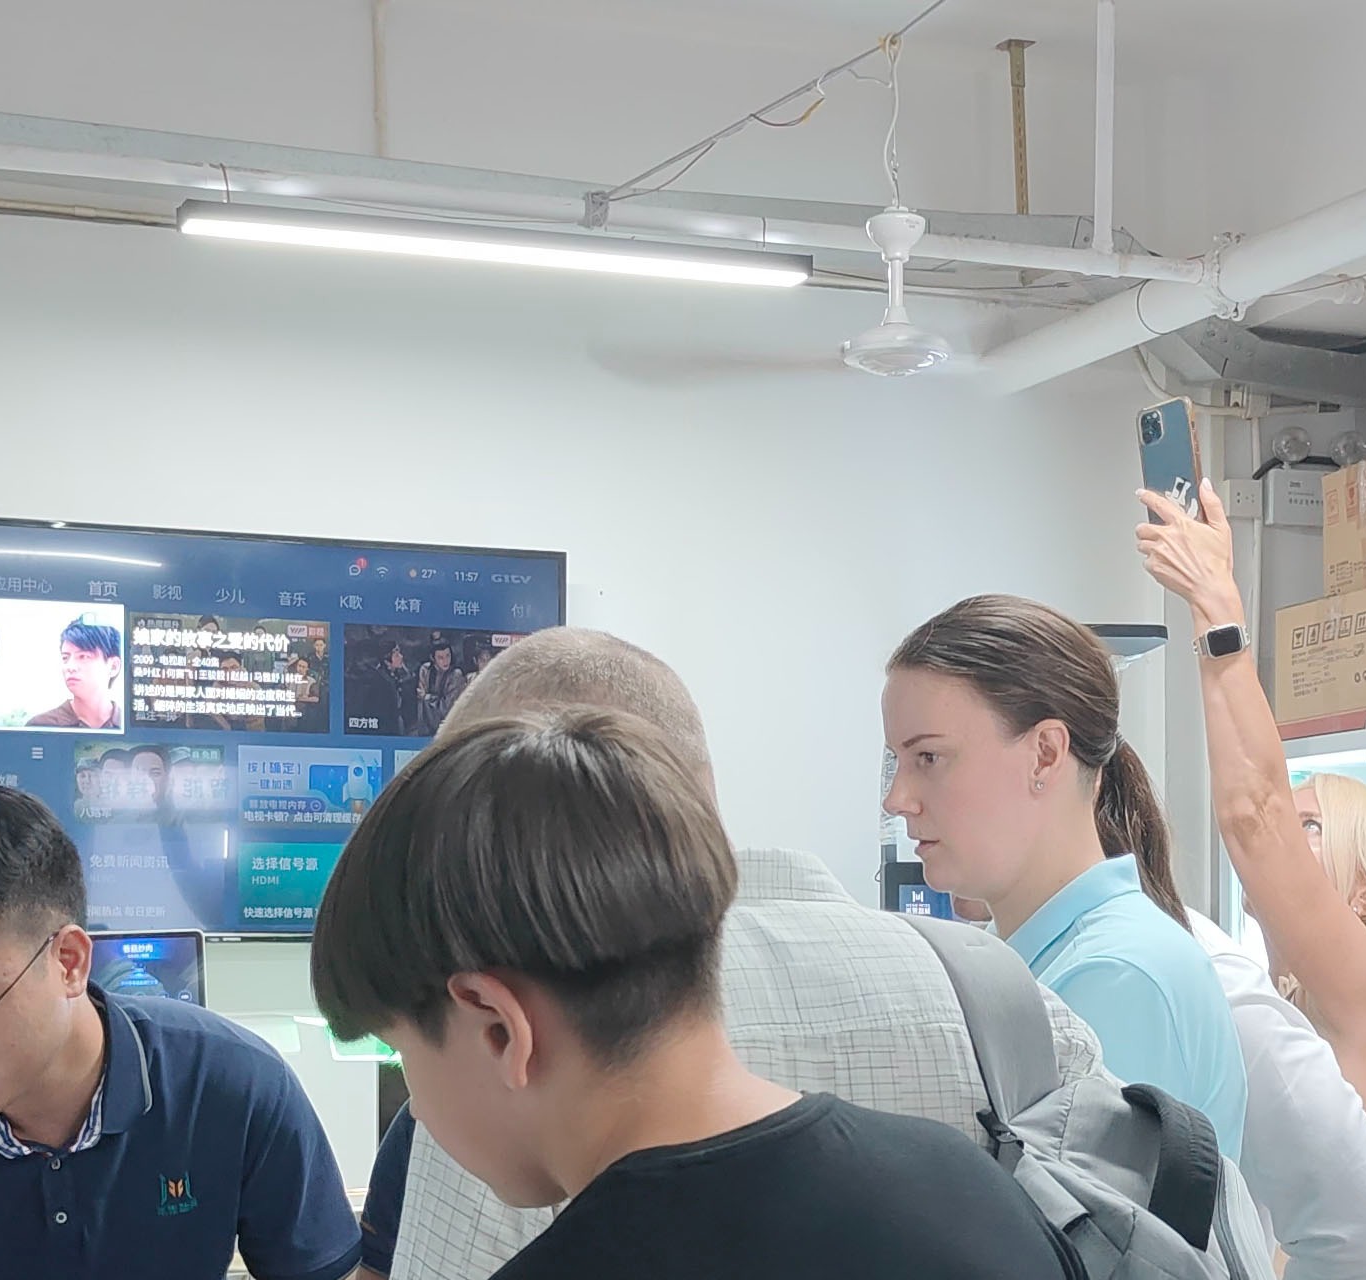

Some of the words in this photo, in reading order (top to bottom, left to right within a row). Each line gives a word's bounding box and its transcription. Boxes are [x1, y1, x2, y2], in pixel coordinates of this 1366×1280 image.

[454, 571, 479, 583] 11:57
[88, 580, 119, 597] 首页
[152, 584, 183, 601] 影视
[215, 588, 246, 604] 少儿
[278, 591, 307, 607] 音乐
[339, 595, 363, 610] K歌
[394, 598, 422, 613] 体育
[453, 601, 481, 616] 陪伴
[133, 627, 290, 652] 娘家的故事之爱的代价
[348, 716, 379, 729] 四方馆
[89, 854, 170, 869] 免费新闻资讯
[251, 857, 319, 871] 选择信号源
[251, 875, 280, 885] HDMI
